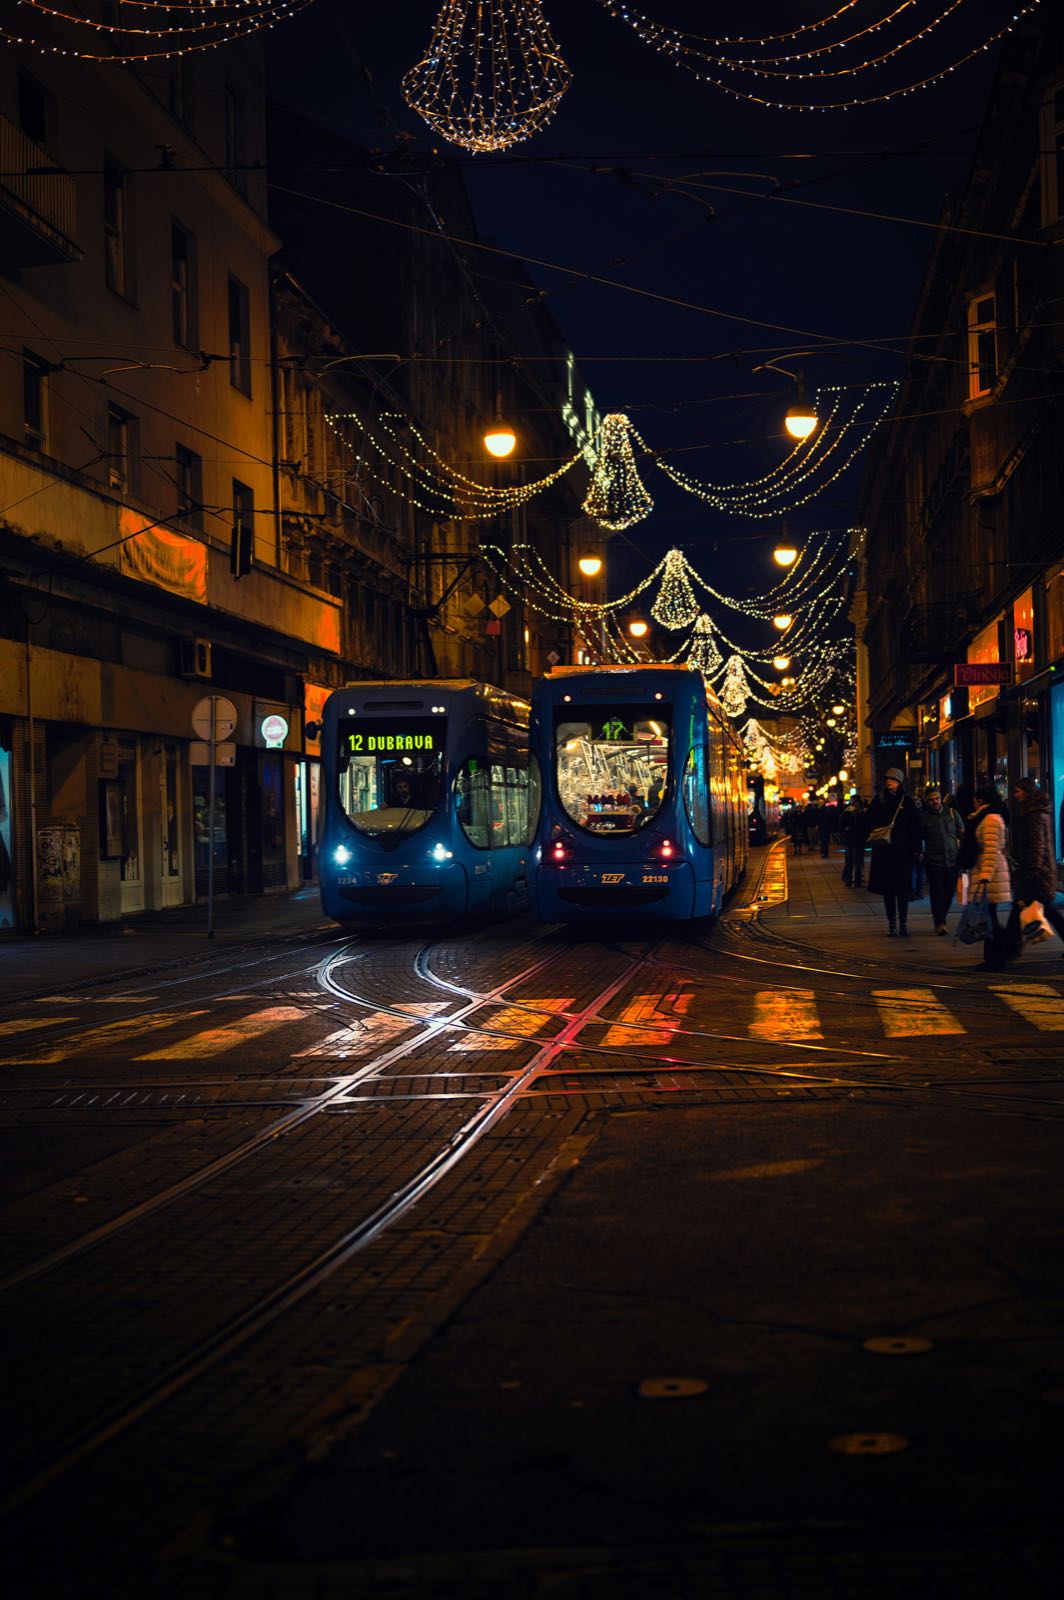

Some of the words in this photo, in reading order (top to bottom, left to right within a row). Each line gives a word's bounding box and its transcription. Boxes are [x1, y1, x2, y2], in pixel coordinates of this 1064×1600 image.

[602, 721, 623, 740] 17
[348, 734, 364, 751] 12
[367, 735, 434, 751] DUBRAVA
